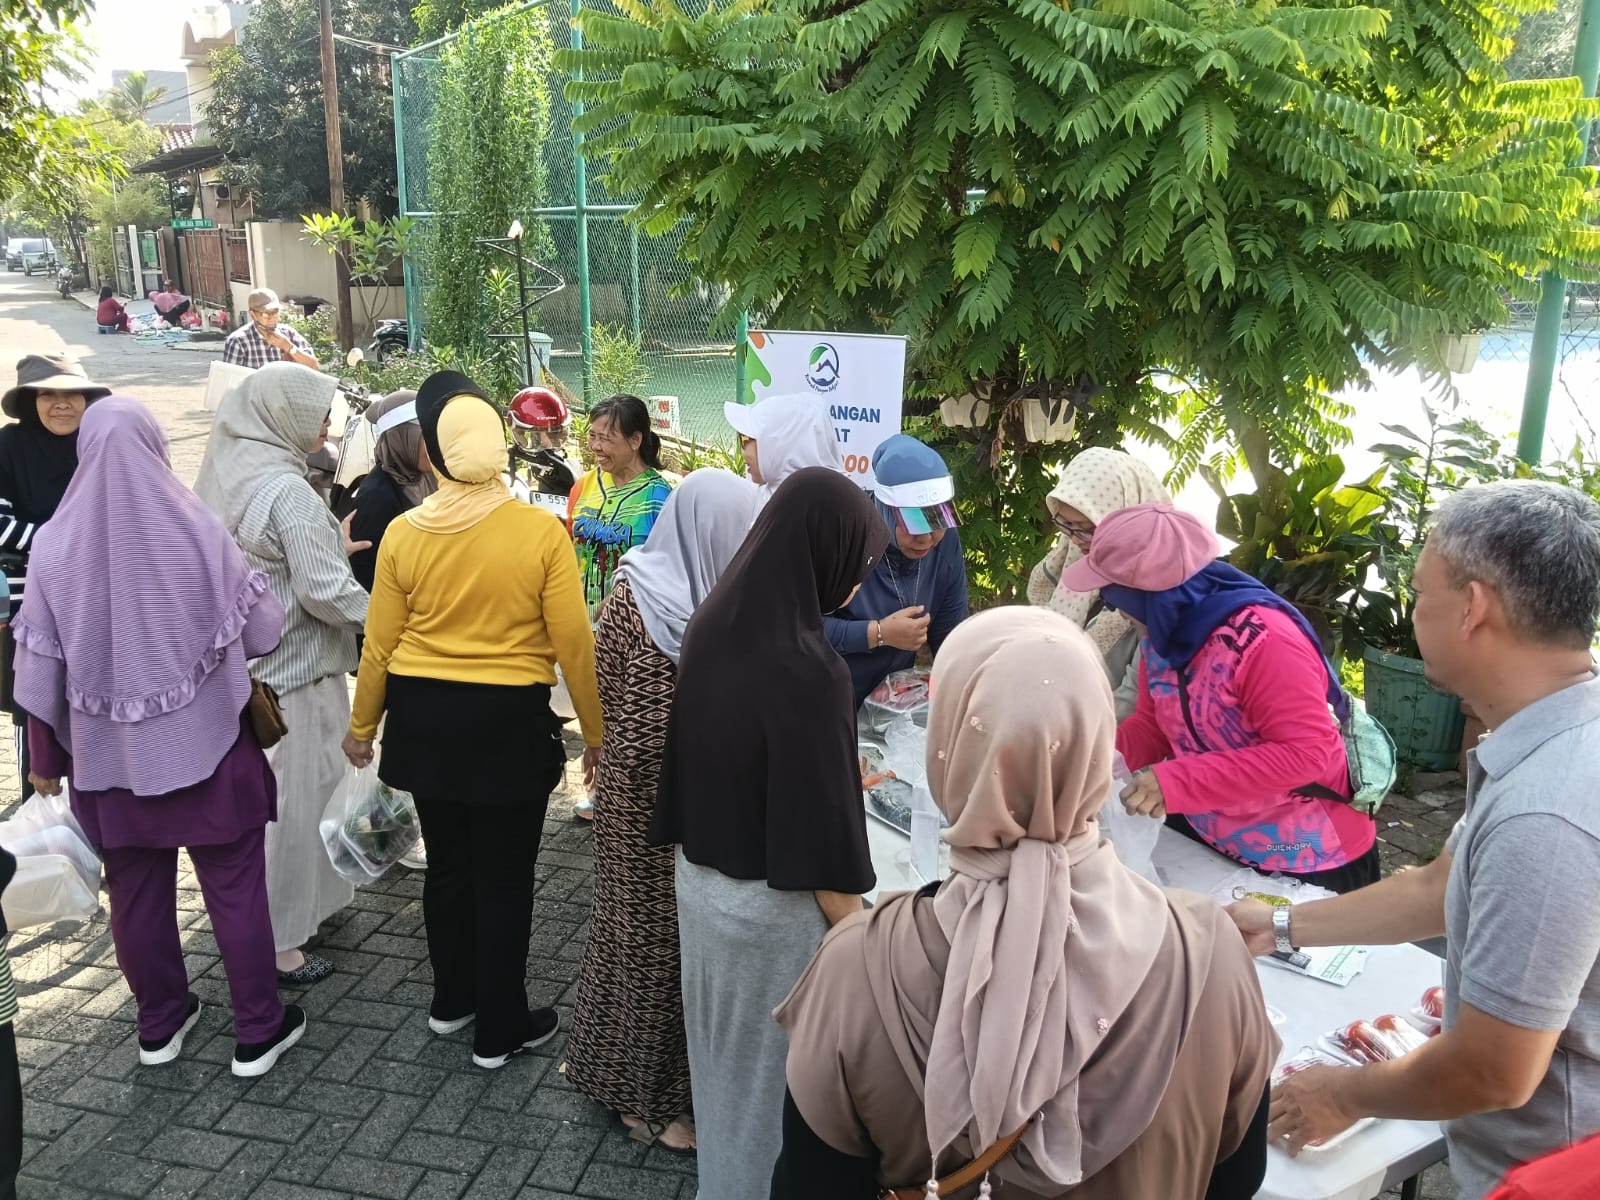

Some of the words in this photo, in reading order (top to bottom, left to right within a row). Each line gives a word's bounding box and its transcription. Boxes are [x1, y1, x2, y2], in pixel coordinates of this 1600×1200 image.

[841, 453, 869, 474] 00
[548, 494, 570, 506] 553
[574, 516, 632, 546] ZUMBA
